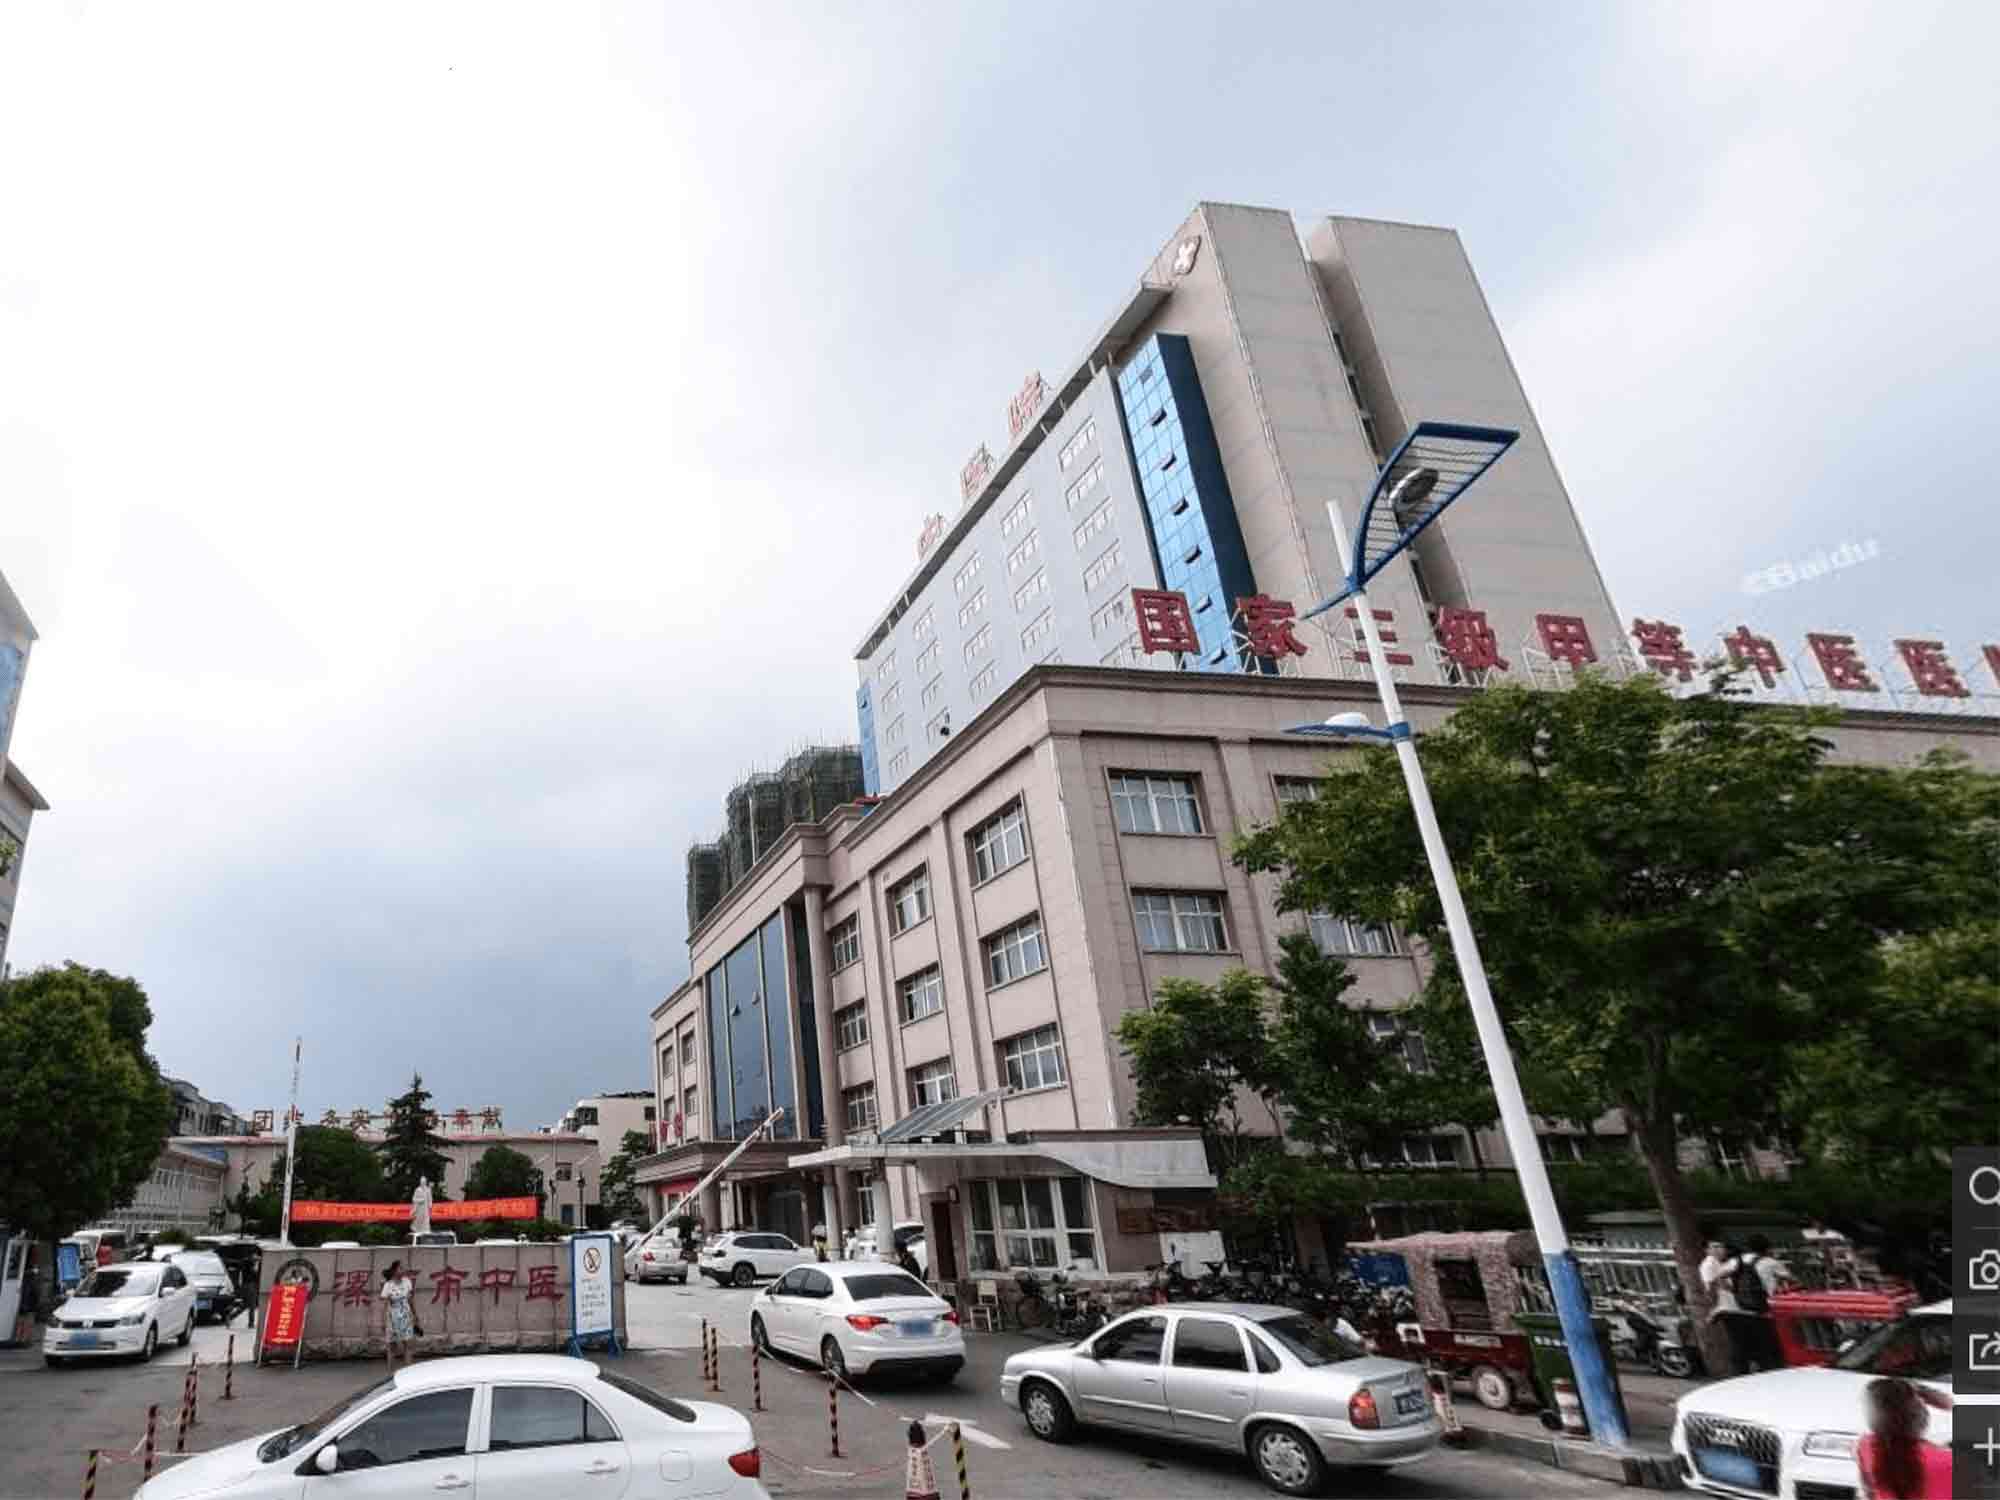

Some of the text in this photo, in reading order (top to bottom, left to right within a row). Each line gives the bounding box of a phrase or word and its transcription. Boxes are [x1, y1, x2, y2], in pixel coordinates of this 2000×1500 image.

[1131, 587, 2000, 698] 国家三级甲等中医医
[333, 1265, 566, 1308] 漯市中医
